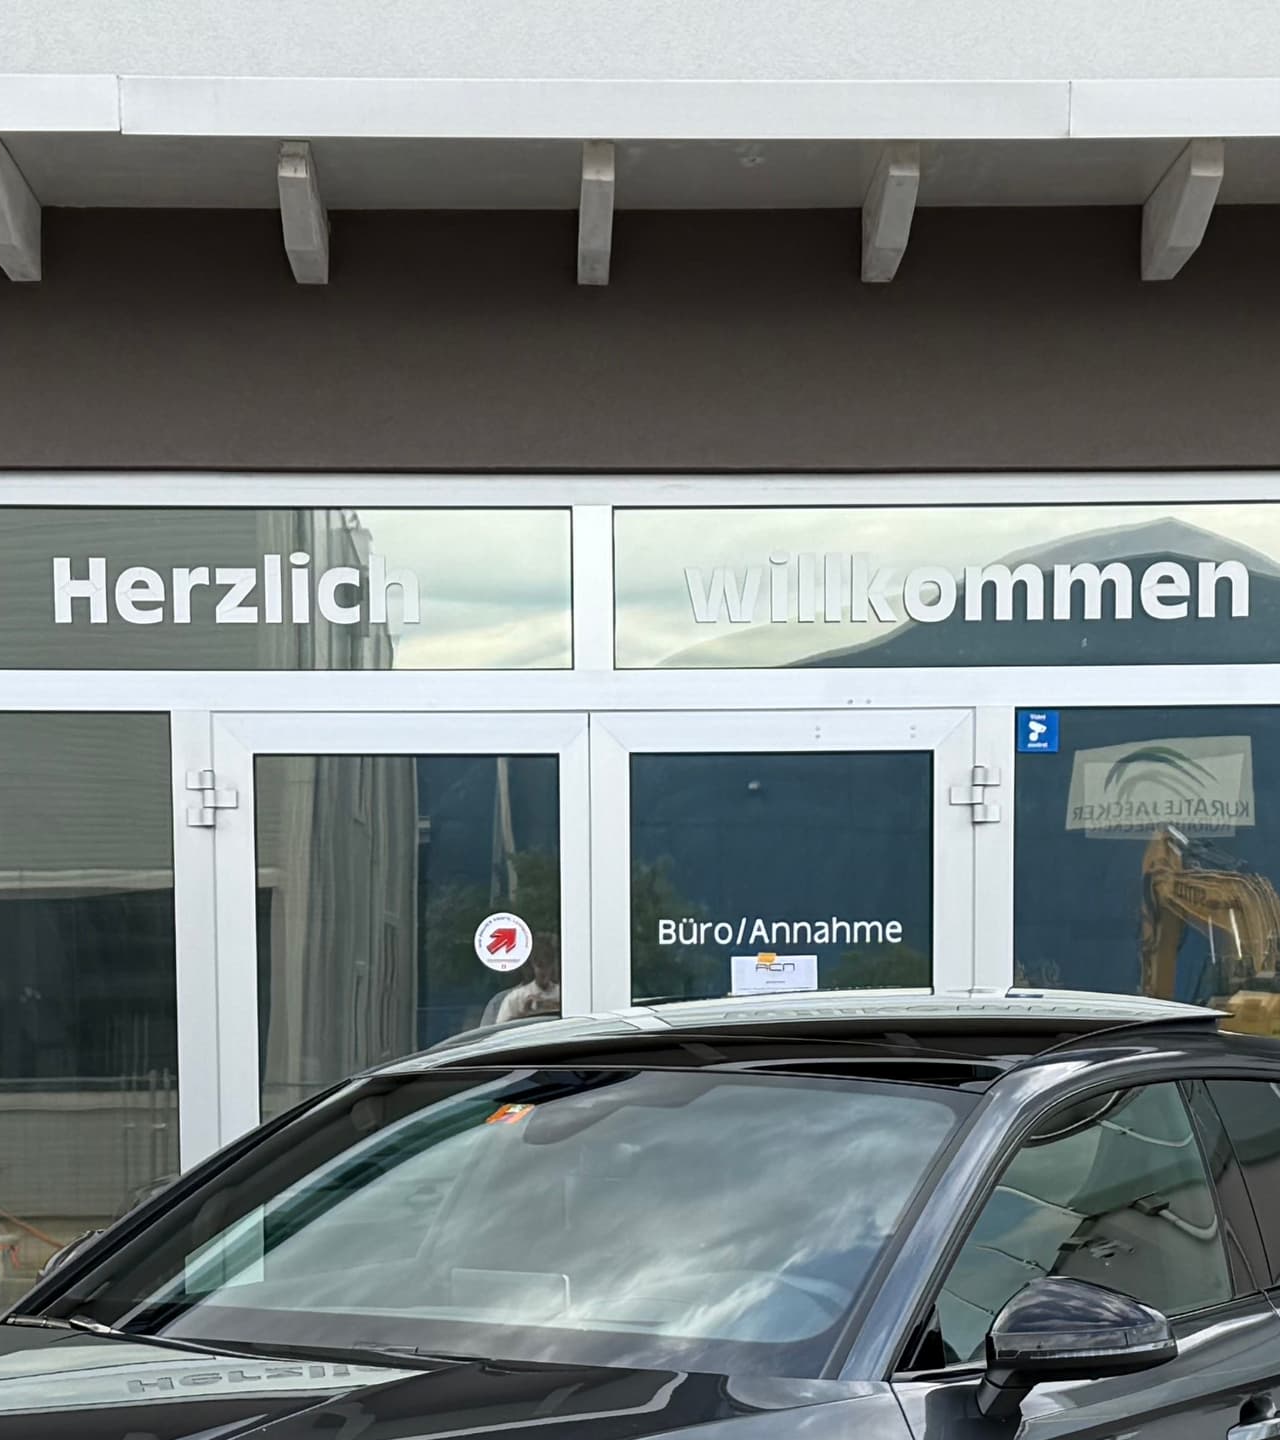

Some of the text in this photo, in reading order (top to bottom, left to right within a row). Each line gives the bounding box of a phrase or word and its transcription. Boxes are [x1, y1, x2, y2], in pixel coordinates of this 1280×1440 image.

[53, 551, 1250, 625] Herzlich willkommen
[658, 917, 902, 945] Büro/Annahme
